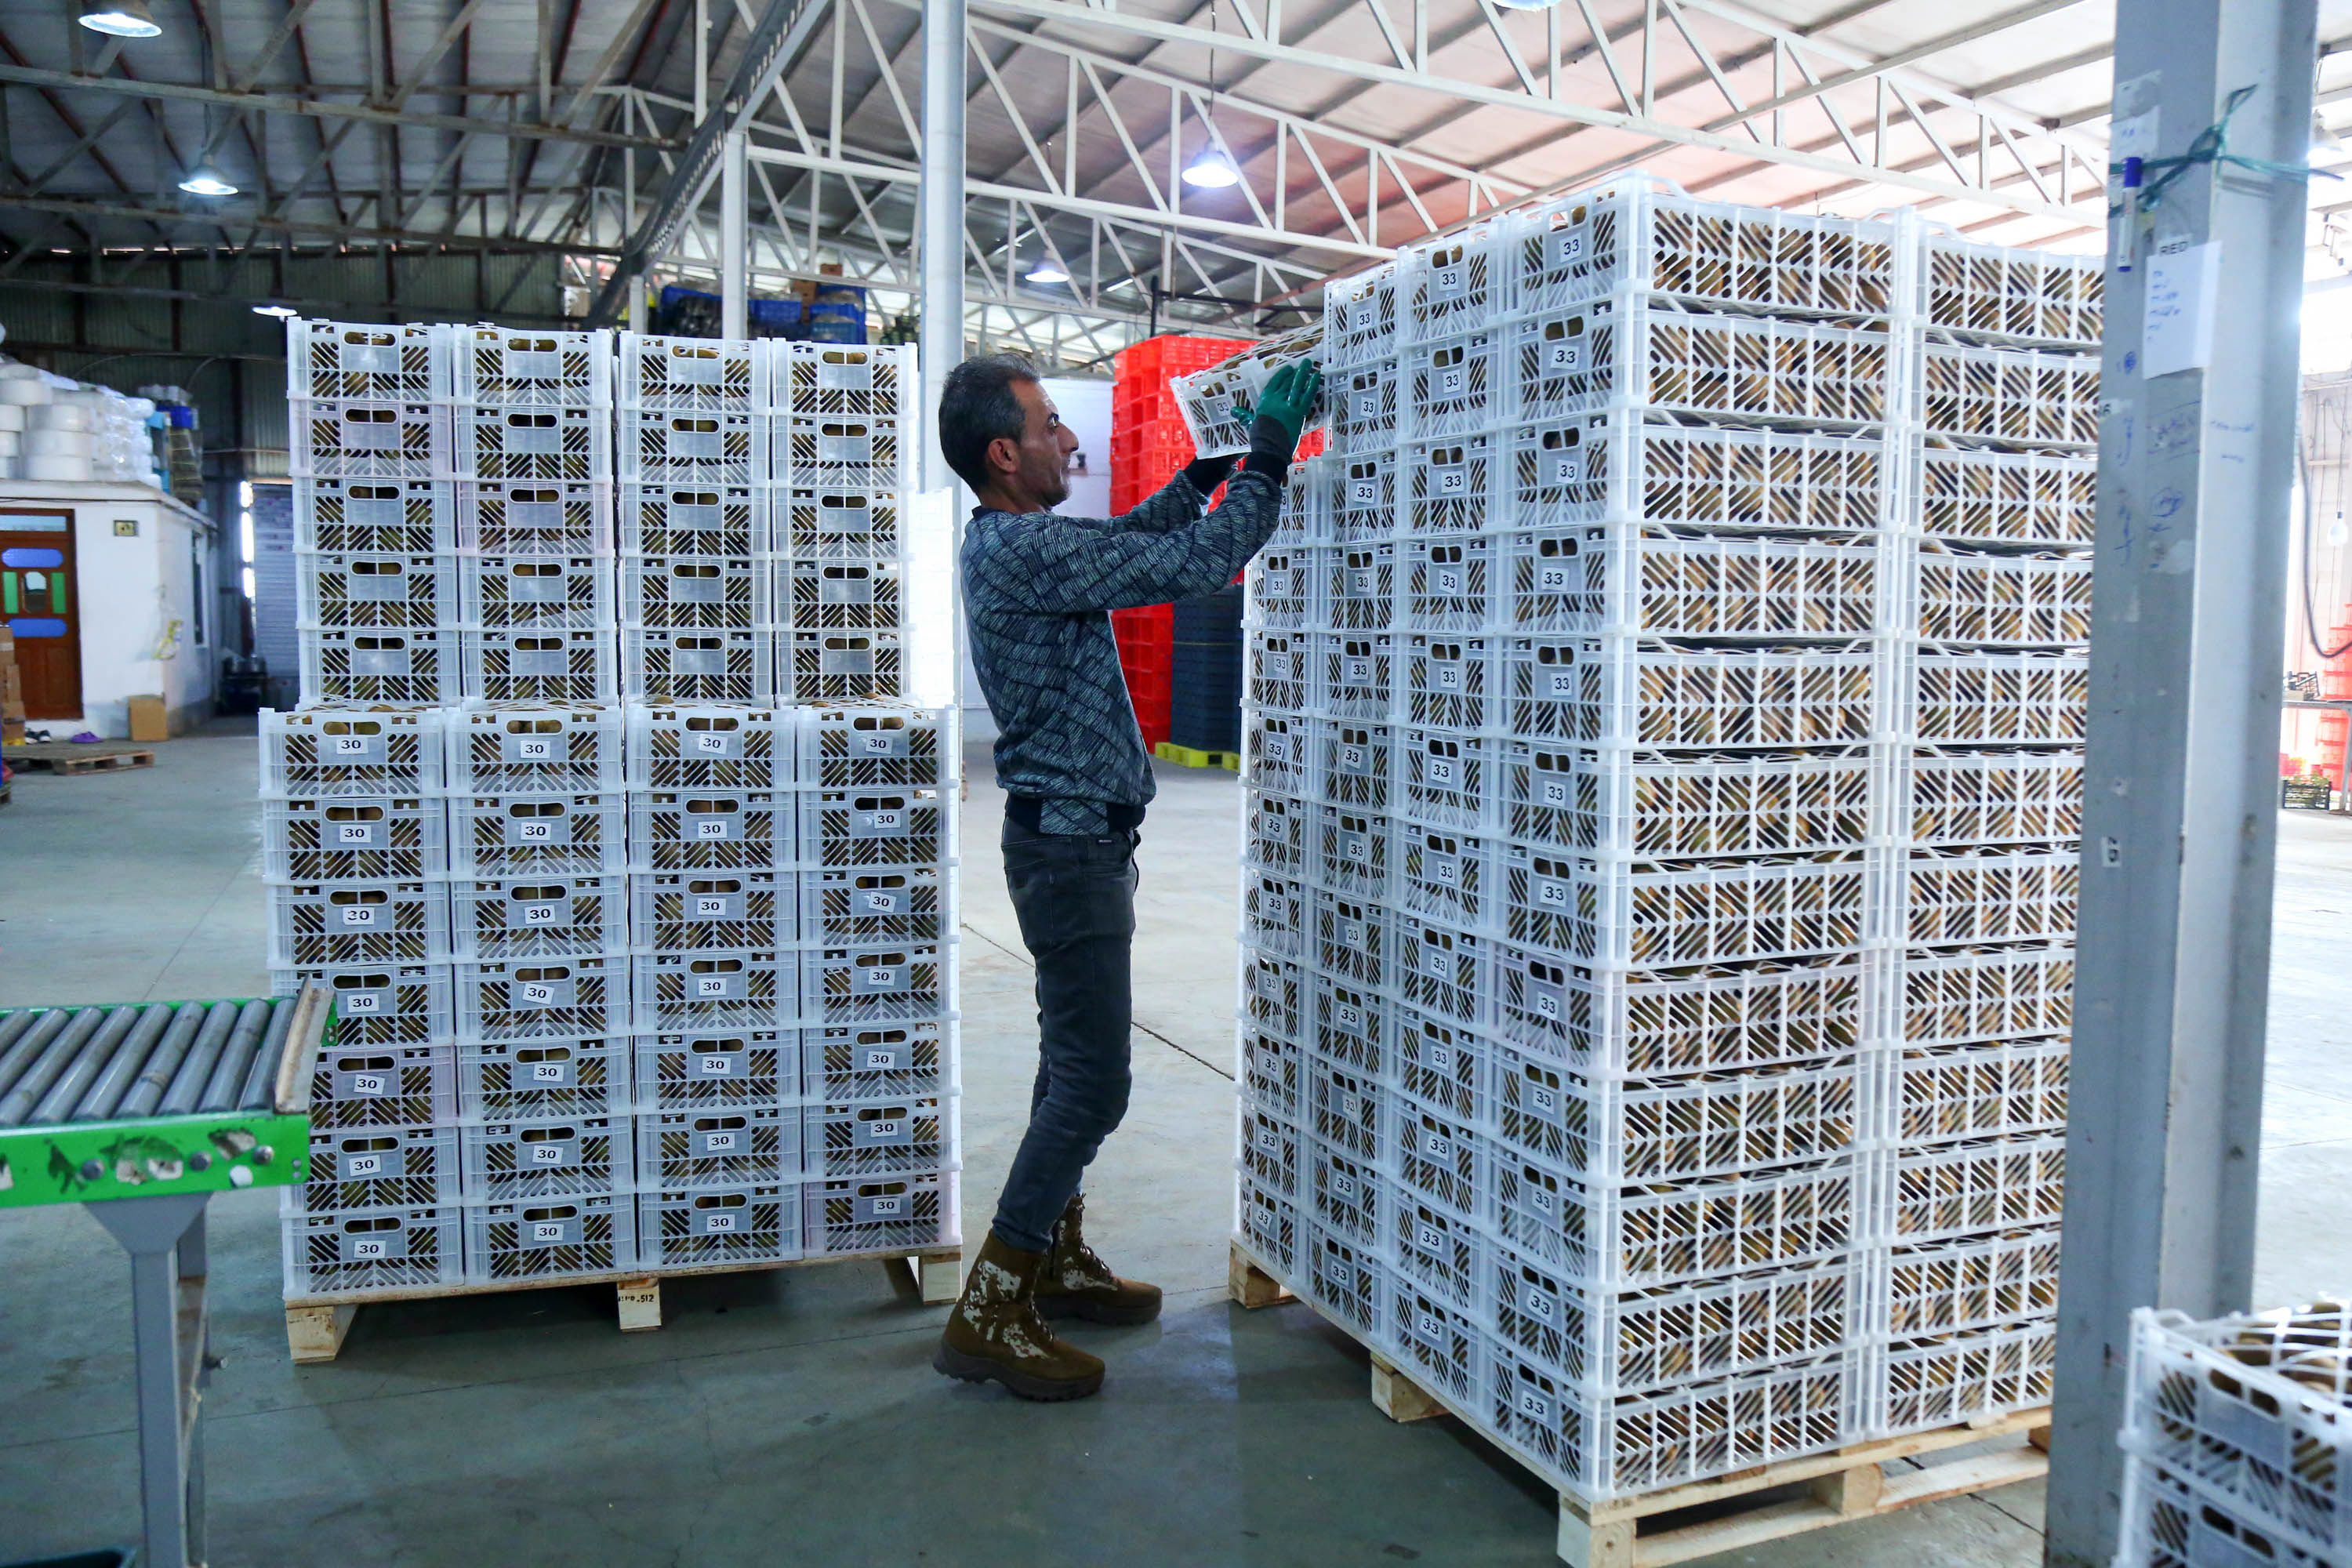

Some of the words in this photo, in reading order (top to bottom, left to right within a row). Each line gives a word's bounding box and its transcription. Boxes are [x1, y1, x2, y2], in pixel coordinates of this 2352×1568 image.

[1563, 238, 1580, 256] 33
[1442, 272, 1457, 285] 33
[1359, 313, 1370, 325] 33
[1555, 350, 1576, 364] 33
[1446, 374, 1459, 388] 33
[1363, 401, 1374, 413] 33
[1559, 464, 1575, 479] 33
[1444, 474, 1462, 488] 33
[1357, 487, 1373, 499] 33
[1357, 576, 1369, 589] 33
[1442, 575, 1456, 589] 33
[1544, 572, 1563, 586] 33
[1276, 658, 1287, 670] 33
[1353, 664, 1367, 675] 33
[1443, 670, 1456, 683] 33
[1555, 677, 1570, 690] 33
[341, 739, 361, 750] 30
[524, 744, 544, 753] 30
[702, 738, 721, 749] 30
[869, 739, 887, 749] 30
[1268, 742, 1282, 756] 33
[1345, 749, 1359, 763] 33
[1433, 764, 1450, 778] 33
[1548, 786, 1563, 800] 33
[877, 815, 895, 825] 30
[1268, 818, 1280, 833] 33
[344, 828, 365, 838] 30
[524, 826, 546, 837] 30
[702, 824, 721, 834] 30
[1350, 844, 1363, 857] 33
[1440, 865, 1453, 879] 33
[1544, 886, 1564, 901] 33
[701, 902, 720, 911] 30
[873, 896, 890, 907] 30
[1269, 898, 1282, 910] 33
[347, 910, 370, 921] 30
[529, 908, 551, 920] 30
[1433, 956, 1446, 972] 33
[873, 971, 890, 981] 30
[703, 982, 721, 991] 30
[528, 987, 547, 999] 30
[352, 997, 372, 1007] 30
[1541, 996, 1556, 1014] 33
[1341, 1008, 1357, 1023] 33
[871, 1054, 889, 1064] 30
[1434, 1051, 1447, 1065] 33
[706, 1060, 725, 1069] 30
[1265, 1058, 1277, 1073] 33
[538, 1067, 557, 1077] 30
[357, 1078, 378, 1089] 30
[1536, 1091, 1552, 1108] 33
[874, 1123, 895, 1133] 30
[711, 1136, 730, 1146] 30
[1261, 1134, 1276, 1147] 33
[1430, 1138, 1447, 1155] 33
[537, 1149, 557, 1160] 30
[354, 1160, 374, 1171] 30
[1337, 1177, 1352, 1192] 33
[877, 1201, 895, 1210] 30
[1535, 1191, 1550, 1210] 33
[710, 1218, 729, 1228] 30
[539, 1227, 557, 1236] 30
[1422, 1231, 1439, 1247] 33
[358, 1244, 379, 1254] 30
[1332, 1265, 1348, 1281] 33
[1530, 1294, 1550, 1316] 33
[1423, 1318, 1439, 1335] 33
[1524, 1397, 1544, 1415] 33
